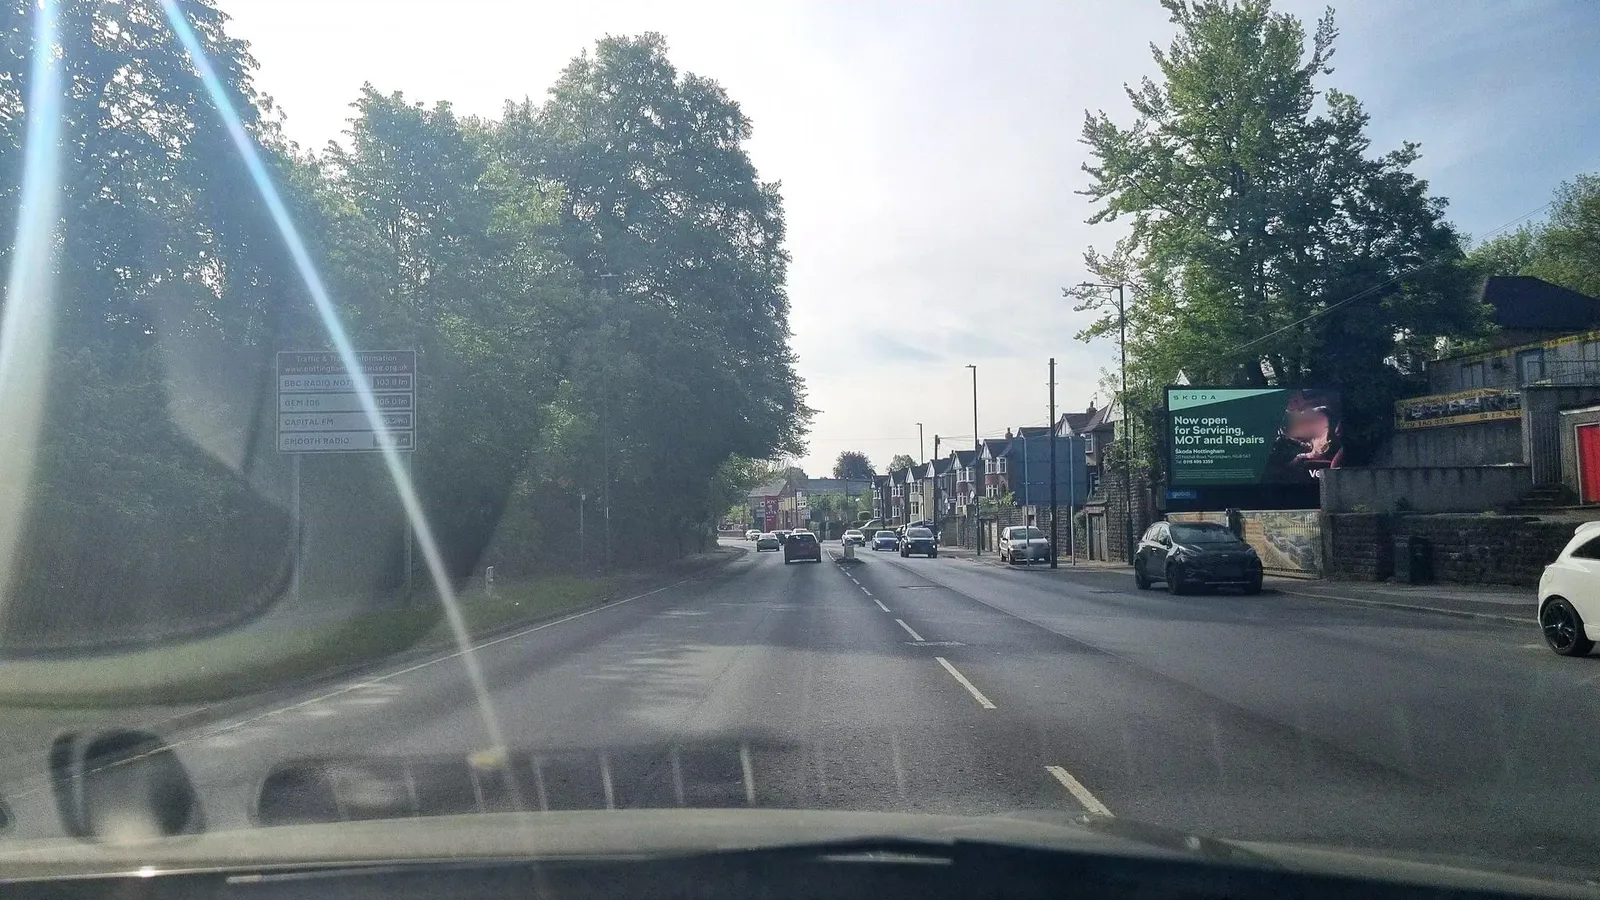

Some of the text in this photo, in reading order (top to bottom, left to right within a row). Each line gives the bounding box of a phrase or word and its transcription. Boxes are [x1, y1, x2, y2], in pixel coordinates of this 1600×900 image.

[304, 379, 330, 387] RADIO
[377, 378, 397, 386] 103.8
[284, 399, 303, 407] GEM
[284, 418, 319, 426] CAPITAL
[321, 418, 334, 426] FM
[1174, 416, 1228, 427] Now open
[1174, 425, 1244, 437] for Servicing,
[323, 437, 350, 445] RADIO
[1175, 435, 1265, 447] MOT and Repairs
[1193, 448, 1225, 456] Nottingham
